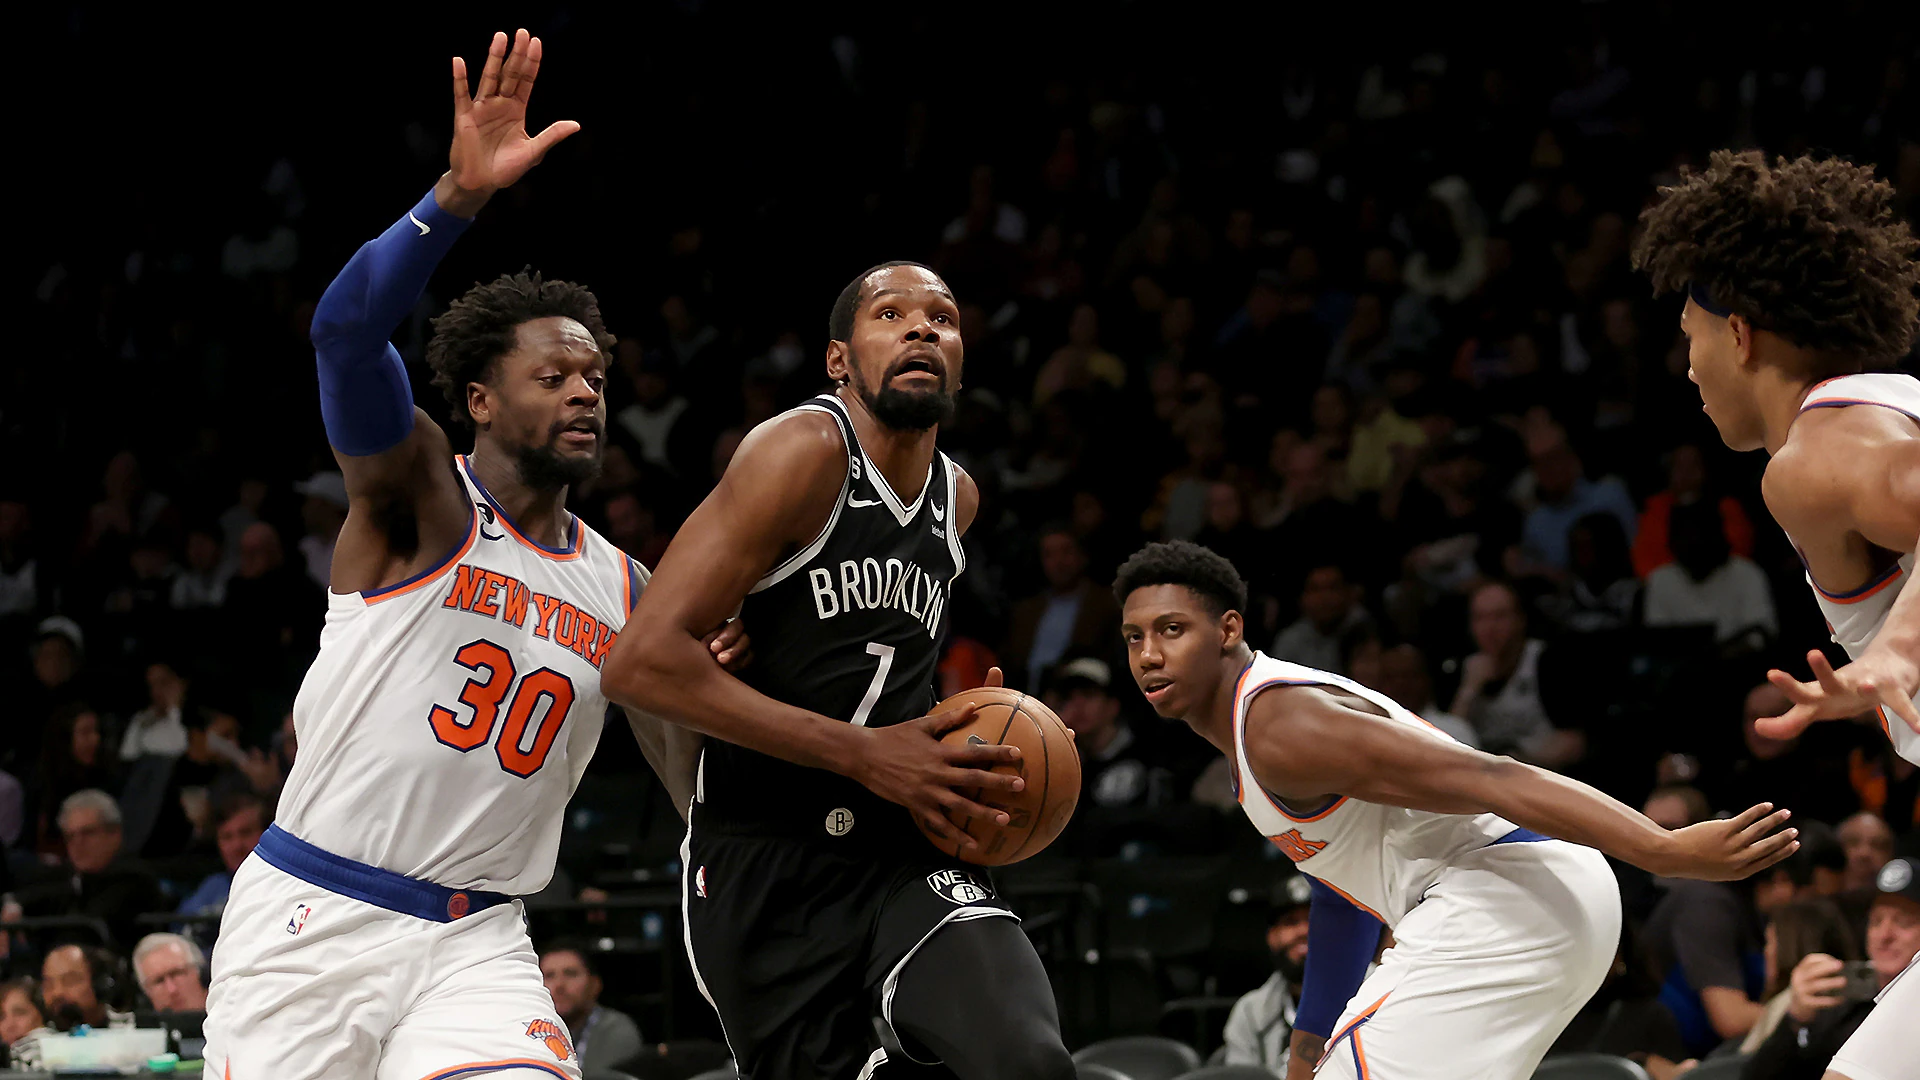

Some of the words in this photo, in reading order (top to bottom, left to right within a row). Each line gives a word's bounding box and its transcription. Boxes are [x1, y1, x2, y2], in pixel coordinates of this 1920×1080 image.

[851, 455, 861, 480] 6
[442, 563, 531, 630] NEW
[533, 592, 618, 672] YORK
[809, 557, 944, 640] BROOKLYN
[428, 638, 576, 780] 30
[850, 642, 895, 726] 7
